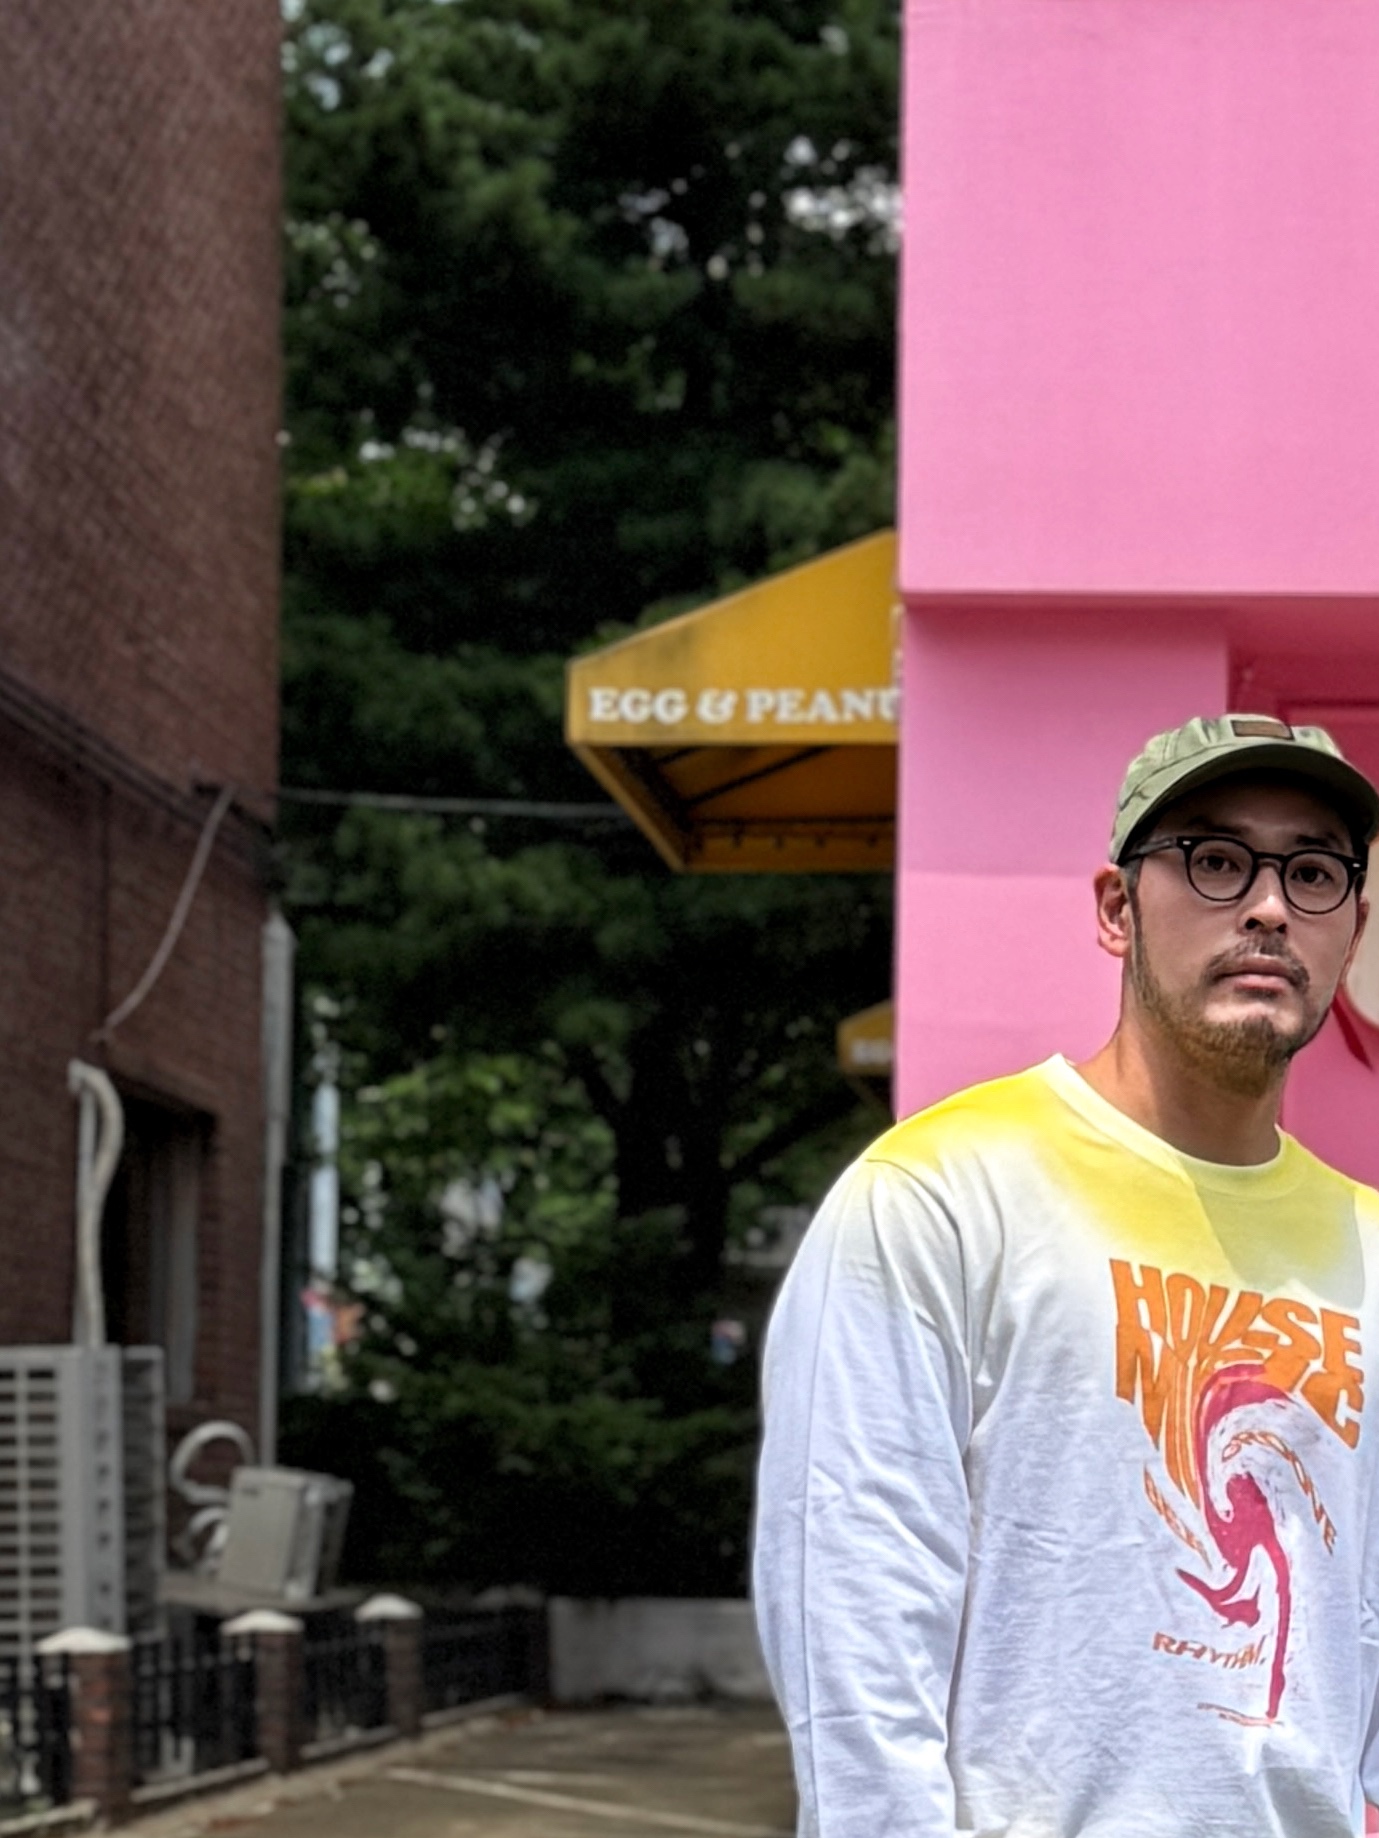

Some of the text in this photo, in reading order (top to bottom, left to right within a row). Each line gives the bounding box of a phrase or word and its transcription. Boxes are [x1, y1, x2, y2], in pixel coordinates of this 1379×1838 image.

[588, 686, 688, 724] EGG
[696, 687, 739, 724] &
[1109, 1258, 1364, 1385] HOUSE
